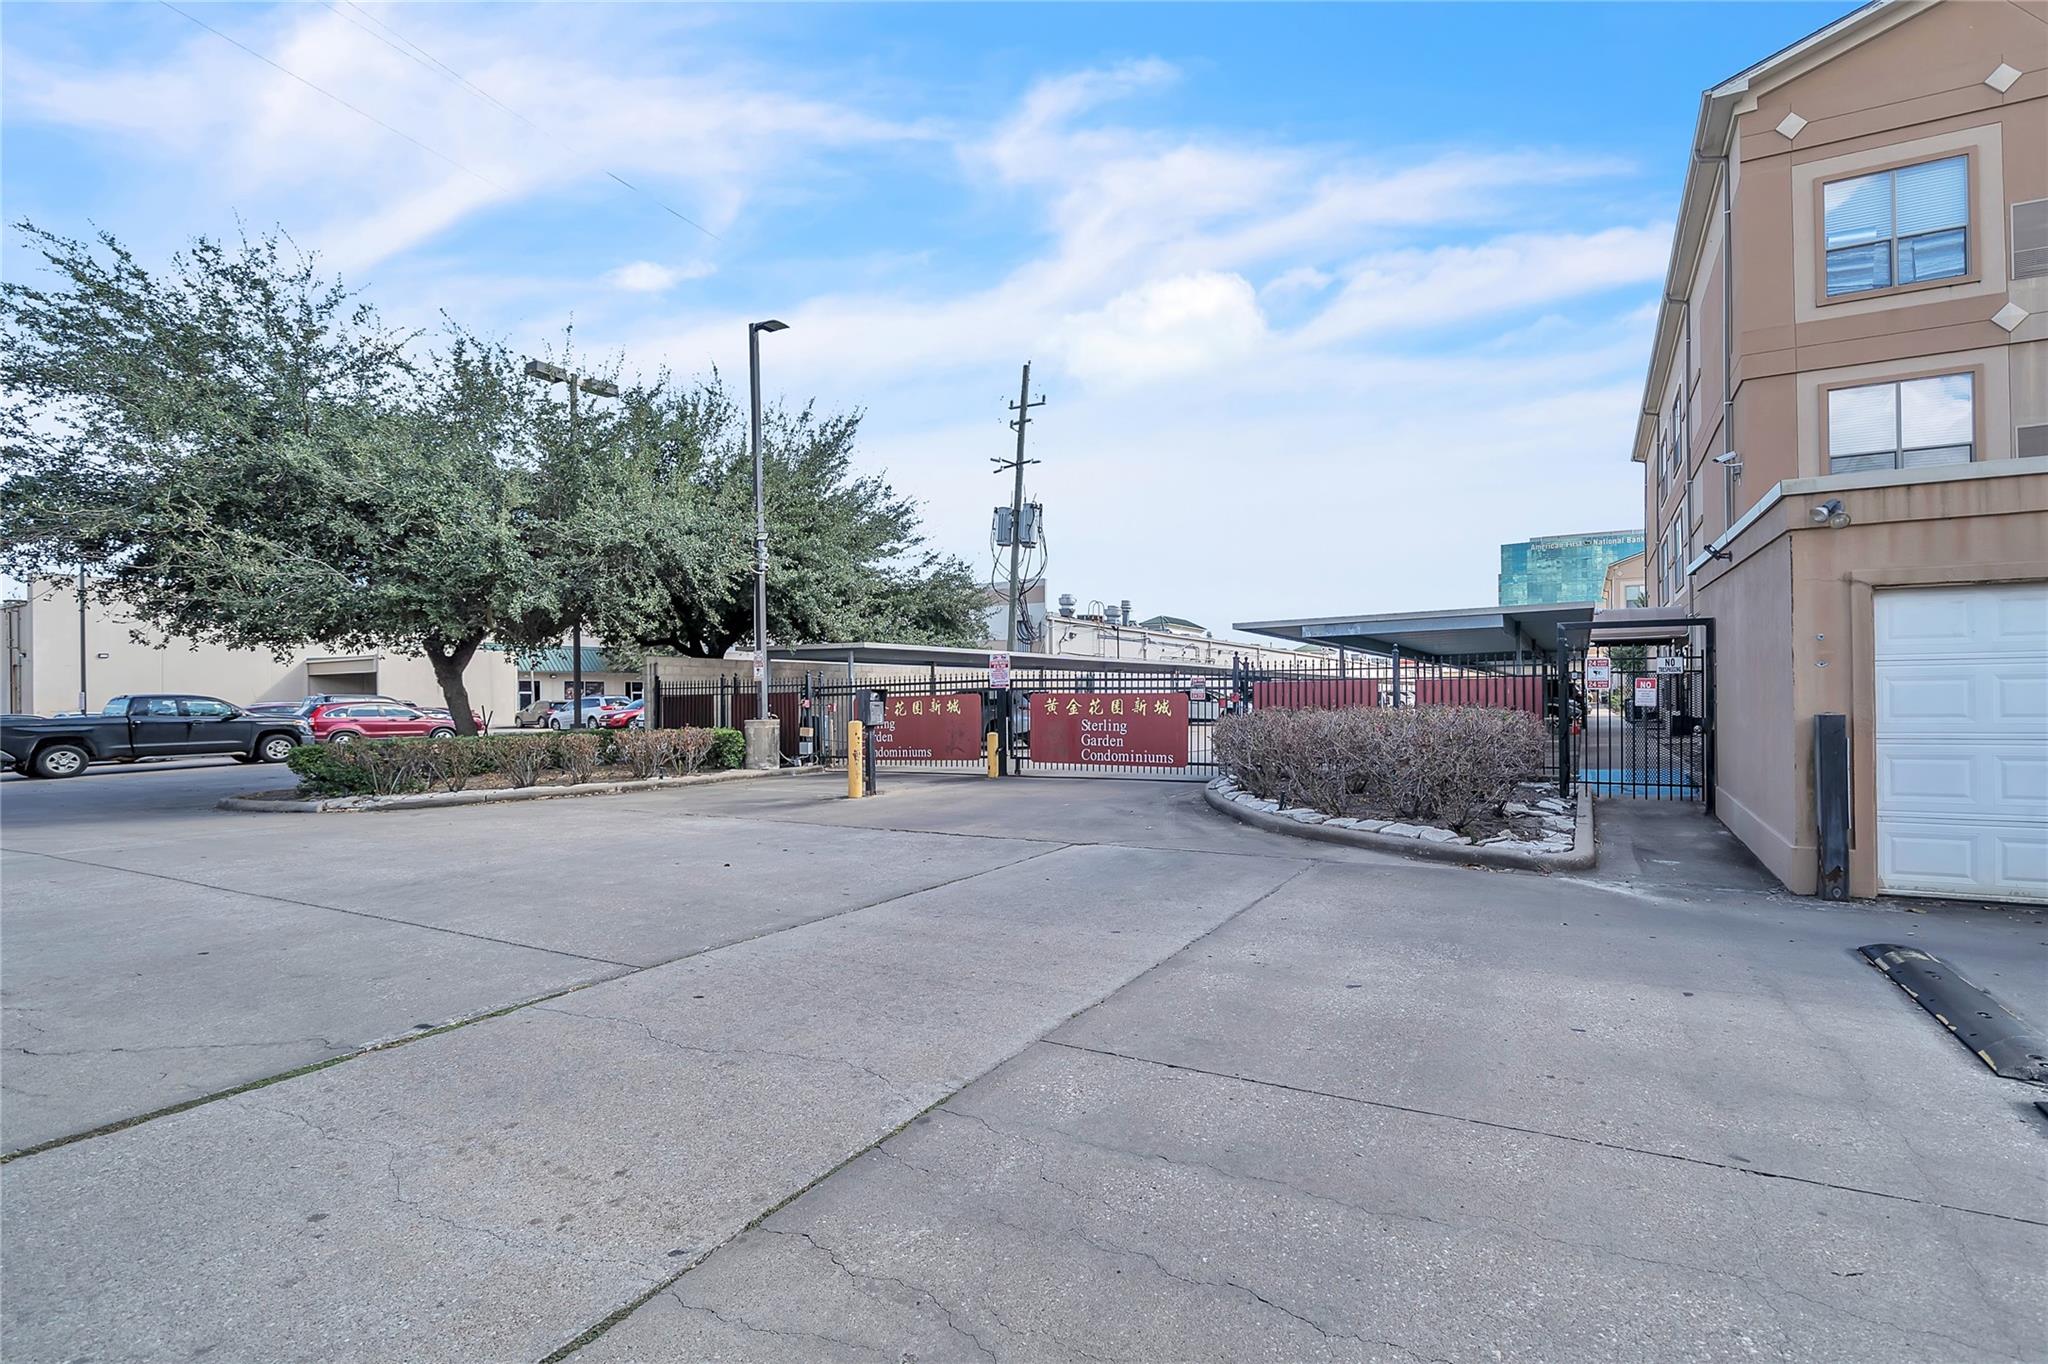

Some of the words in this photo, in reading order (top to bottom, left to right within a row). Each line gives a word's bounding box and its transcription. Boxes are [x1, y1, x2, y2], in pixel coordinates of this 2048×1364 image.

[1593, 538, 1624, 546] National
[1626, 536, 1645, 544] Bank
[1664, 658, 1676, 667] NO
[1640, 681, 1652, 689] NO
[1081, 718, 1128, 734] Sterling
[874, 731, 893, 742] den
[1081, 733, 1124, 747] Garden
[875, 746, 932, 758] ndominiums
[1081, 748, 1174, 764] Condominiums
